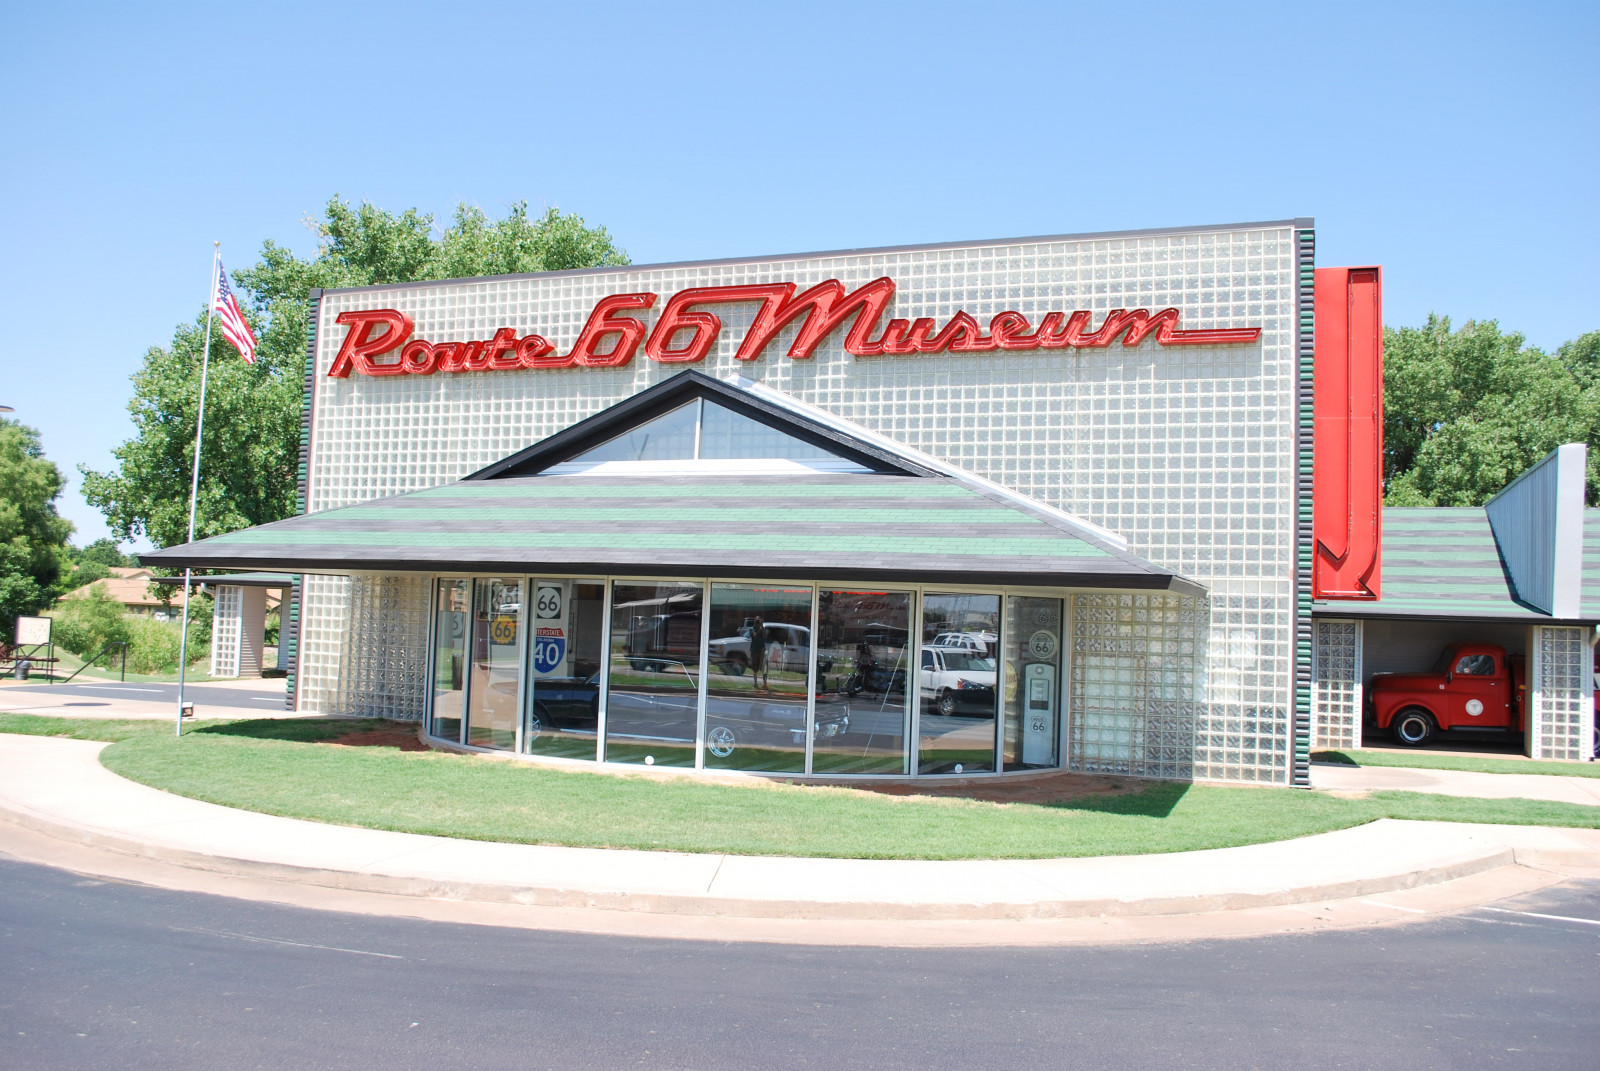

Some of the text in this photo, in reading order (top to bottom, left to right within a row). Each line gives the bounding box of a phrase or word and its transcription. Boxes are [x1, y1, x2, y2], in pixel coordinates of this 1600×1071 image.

[327, 276, 1263, 379] Route 66 Museum
[537, 594, 558, 612] 66
[494, 621, 512, 638] 66
[534, 643, 559, 665] 40
[1035, 642, 1050, 653] 66
[1032, 722, 1045, 731] 66
